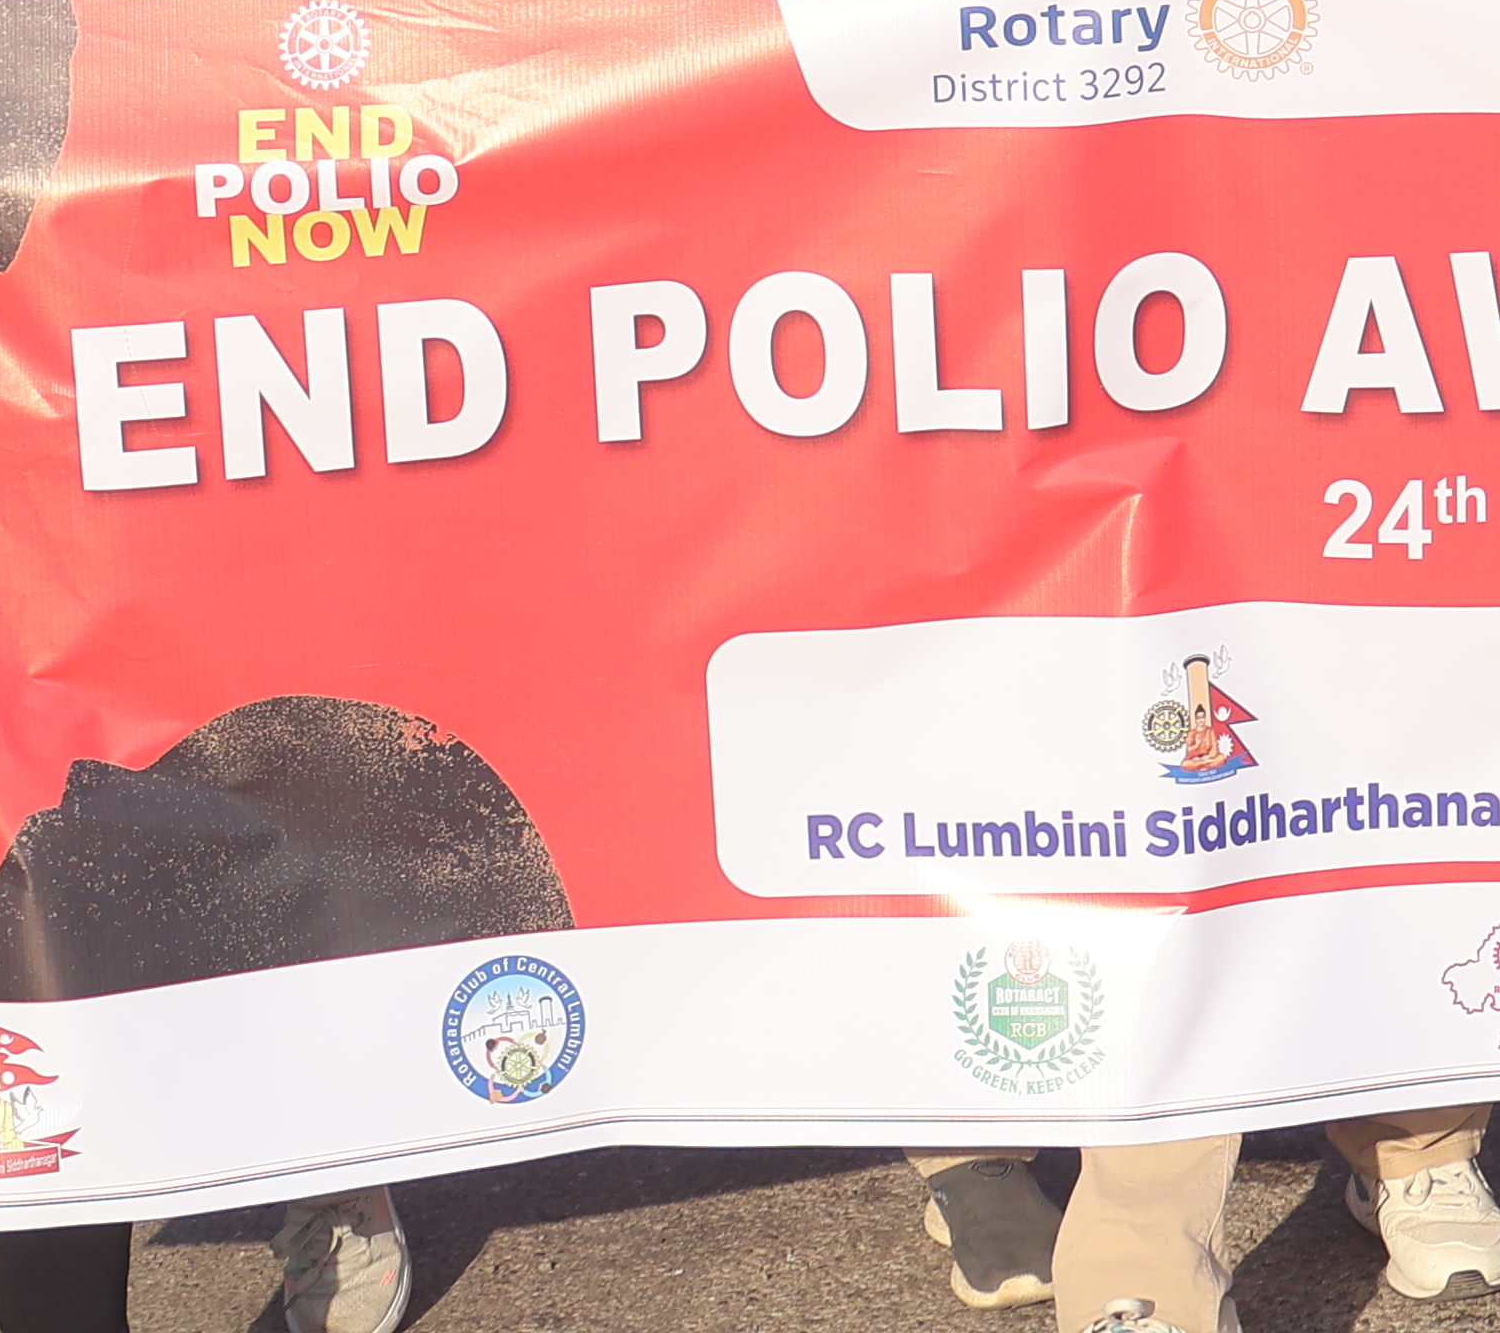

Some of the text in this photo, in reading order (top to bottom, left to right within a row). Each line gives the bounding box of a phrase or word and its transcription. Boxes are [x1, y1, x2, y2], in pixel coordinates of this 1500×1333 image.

[933, 61, 1166, 106] District 3292
[237, 104, 414, 164] END
[194, 153, 459, 219] POLIO
[228, 204, 427, 267] NOW
[70, 295, 510, 493] END
[589, 250, 1230, 443] POLIO
[1322, 475, 1488, 559] 24th
[806, 813, 886, 863] RC
[905, 808, 1127, 858] Lumbini
[448, 958, 581, 1086] Rotaract Club of Central Lumbini
[996, 987, 1060, 1004] ROTARACT
[1010, 1022, 1047, 1038] RCB
